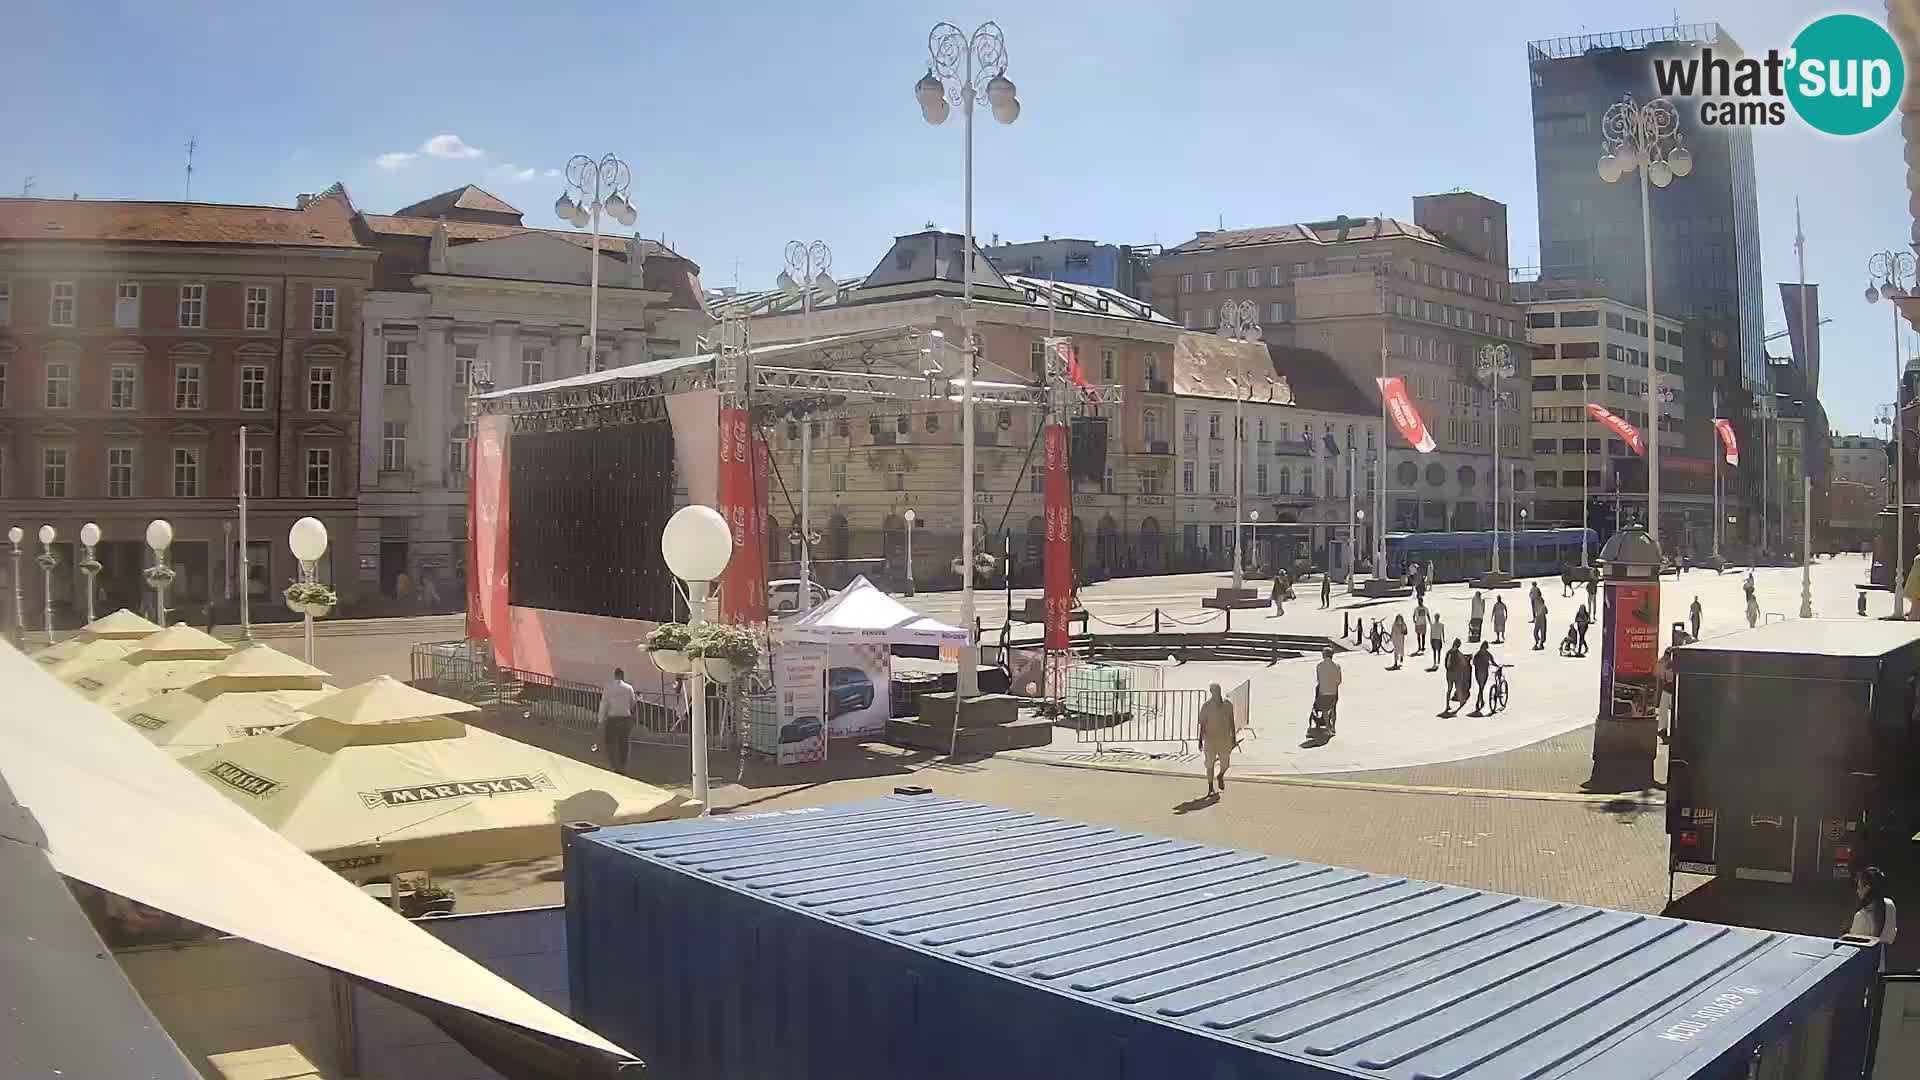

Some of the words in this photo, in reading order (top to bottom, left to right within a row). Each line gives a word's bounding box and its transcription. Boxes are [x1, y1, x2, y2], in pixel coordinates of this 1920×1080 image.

[734, 419, 746, 462] Coca-Cola
[733, 504, 745, 546] Coca-Cola
[391, 778, 529, 803] MARASKA
